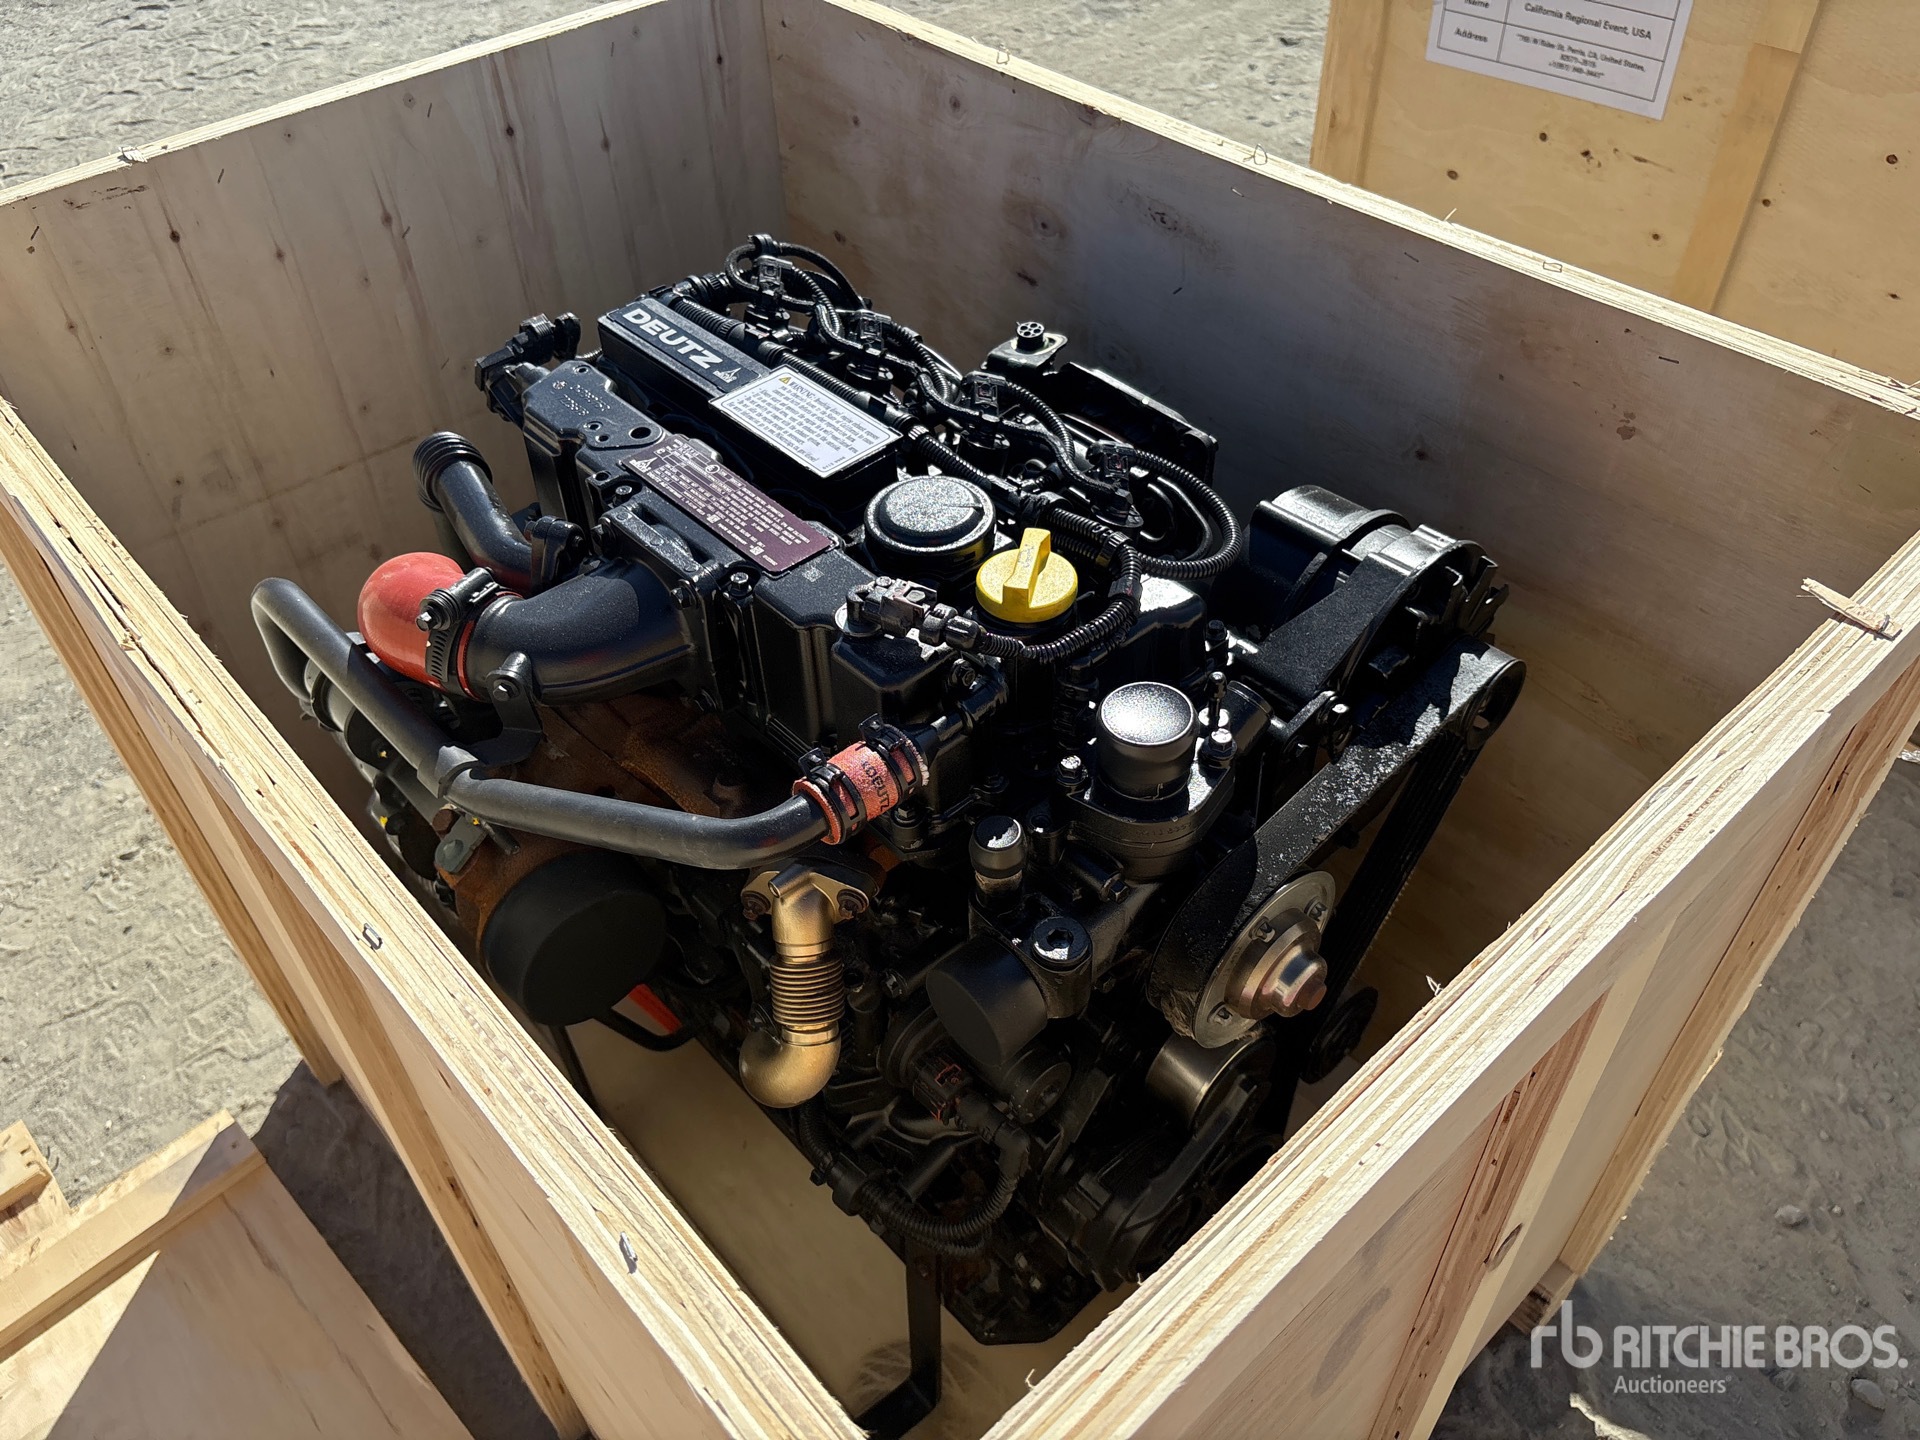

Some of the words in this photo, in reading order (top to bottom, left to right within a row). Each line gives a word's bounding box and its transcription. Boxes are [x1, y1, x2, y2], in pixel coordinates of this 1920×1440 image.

[1454, 27, 1488, 43] Address
[1524, 2, 1563, 19] California
[1565, 11, 1601, 28] Regional
[1603, 20, 1629, 36] Event,
[1632, 26, 1652, 40] USA
[622, 308, 723, 369] DEUTZ
